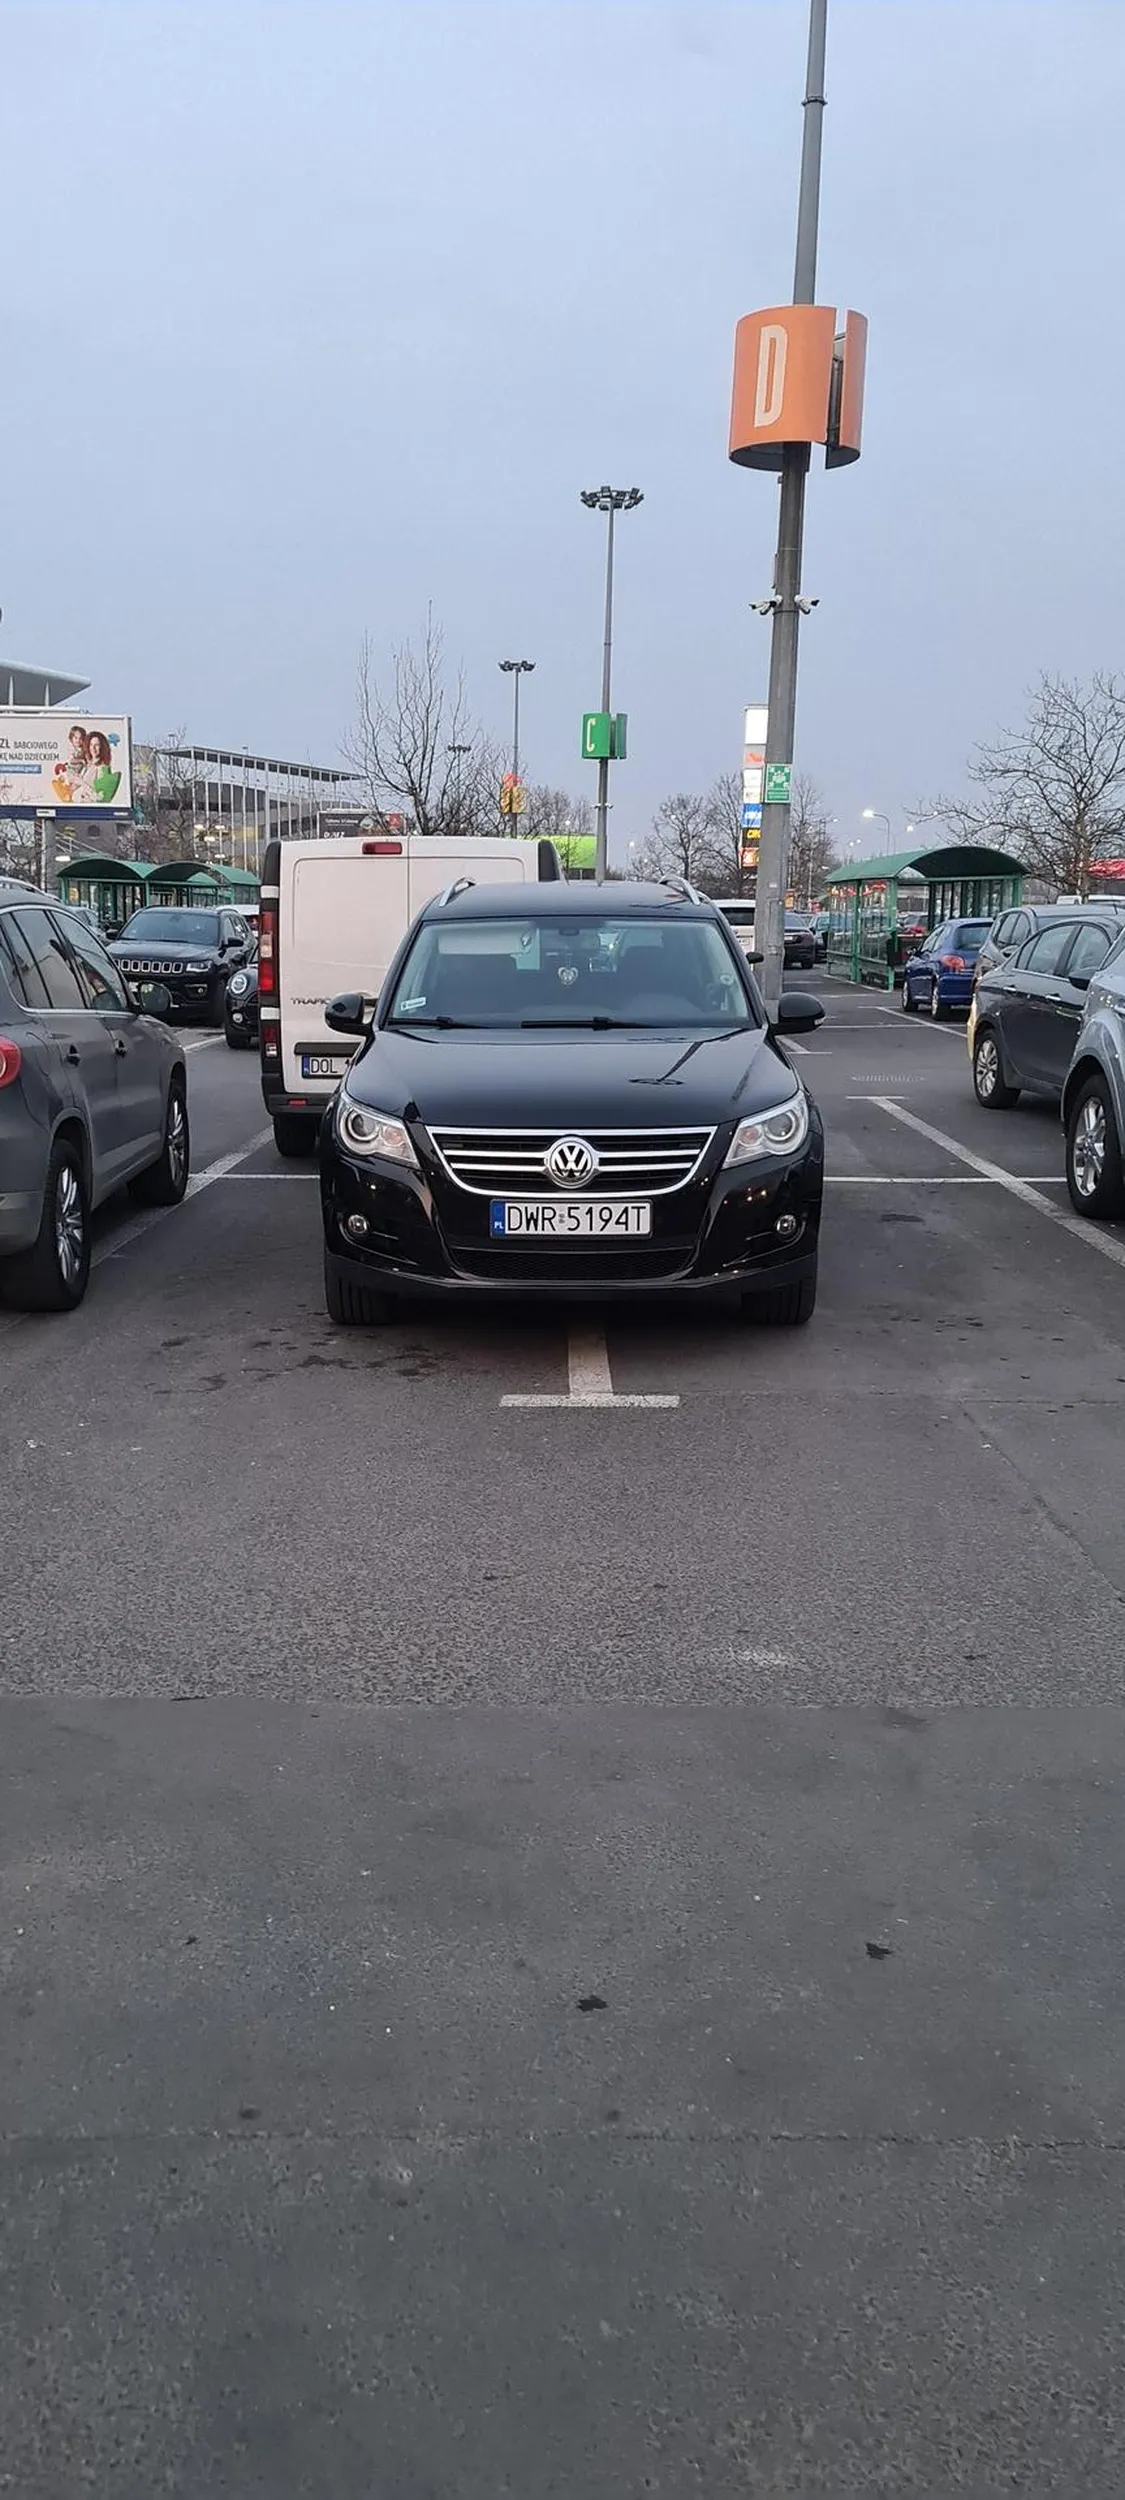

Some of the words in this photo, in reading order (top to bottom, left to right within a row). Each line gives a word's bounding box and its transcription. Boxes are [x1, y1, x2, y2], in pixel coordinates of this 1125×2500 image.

[754, 325, 788, 428] D
[586, 717, 596, 752] C
[14, 741, 58, 750] BABCIOWEGO
[9, 753, 23, 761] NAD
[24, 753, 60, 761] DZIECKIEM
[311, 1058, 338, 1074] DOL
[494, 1221, 504, 1230] PL
[507, 1206, 556, 1232] DWR
[567, 1206, 646, 1232] 5194T
